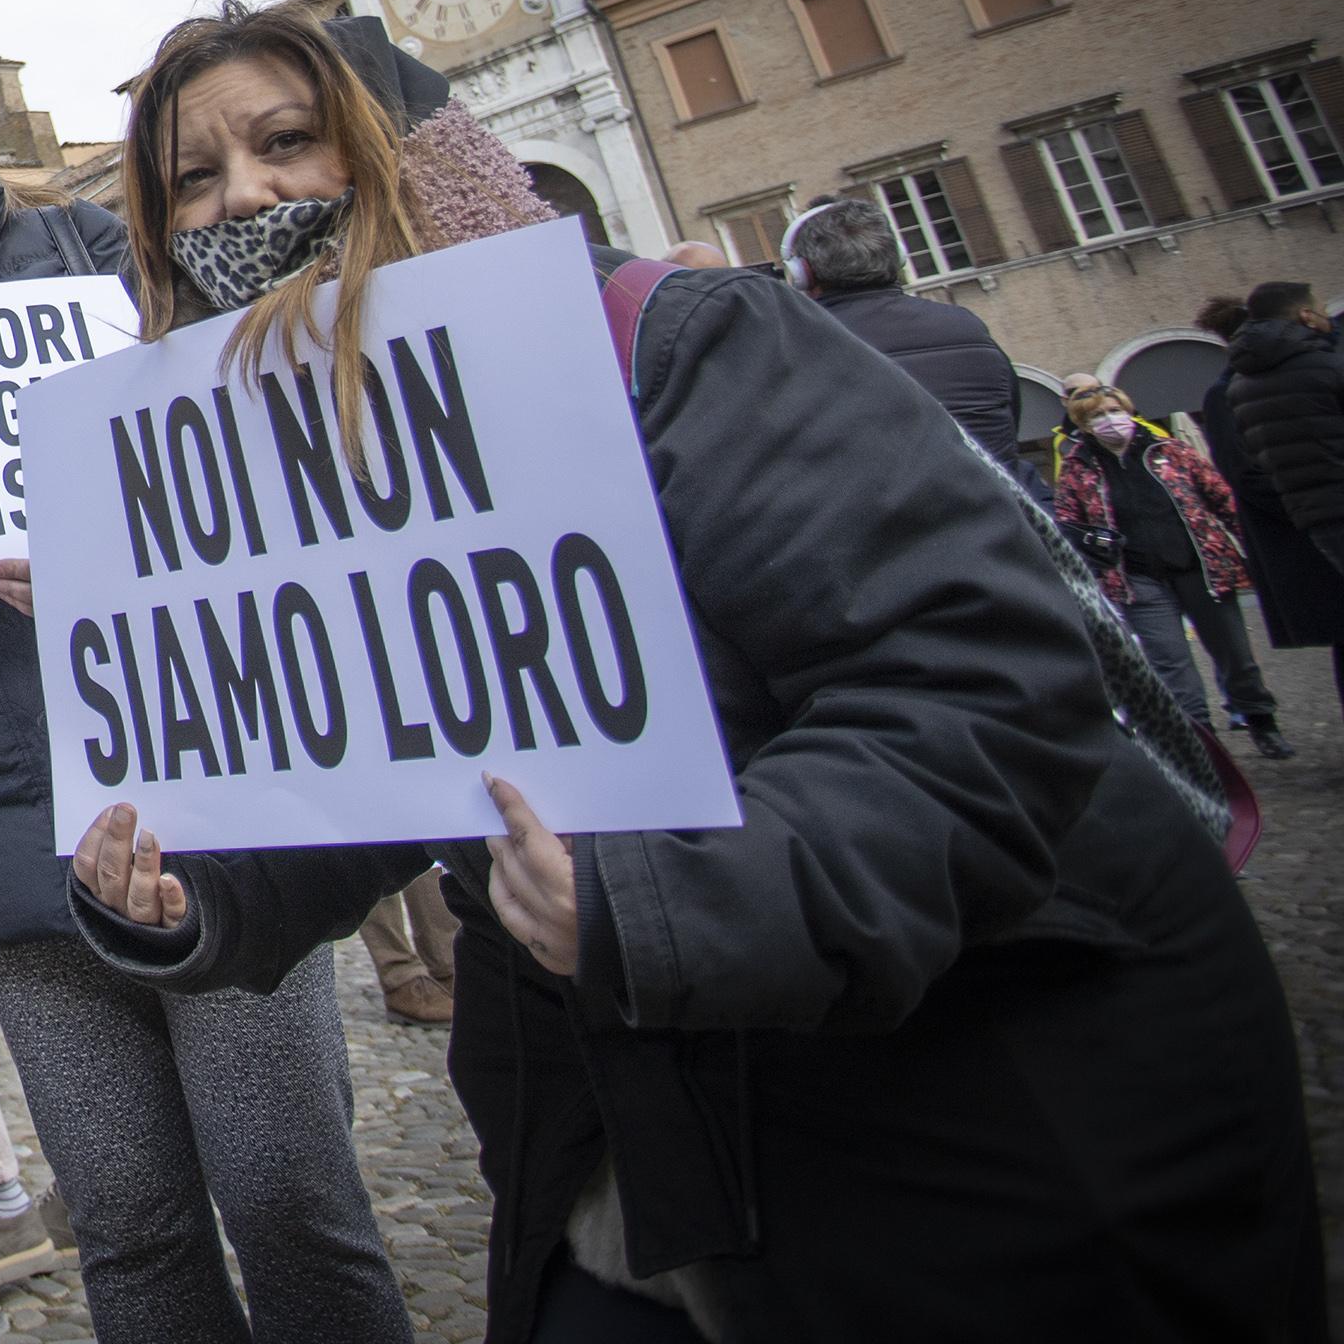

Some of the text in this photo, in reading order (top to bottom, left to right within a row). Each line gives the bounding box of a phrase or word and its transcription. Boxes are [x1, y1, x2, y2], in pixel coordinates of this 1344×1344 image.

[109, 325, 494, 578] NOI NON
[69, 532, 648, 787] SIAMO LORO
